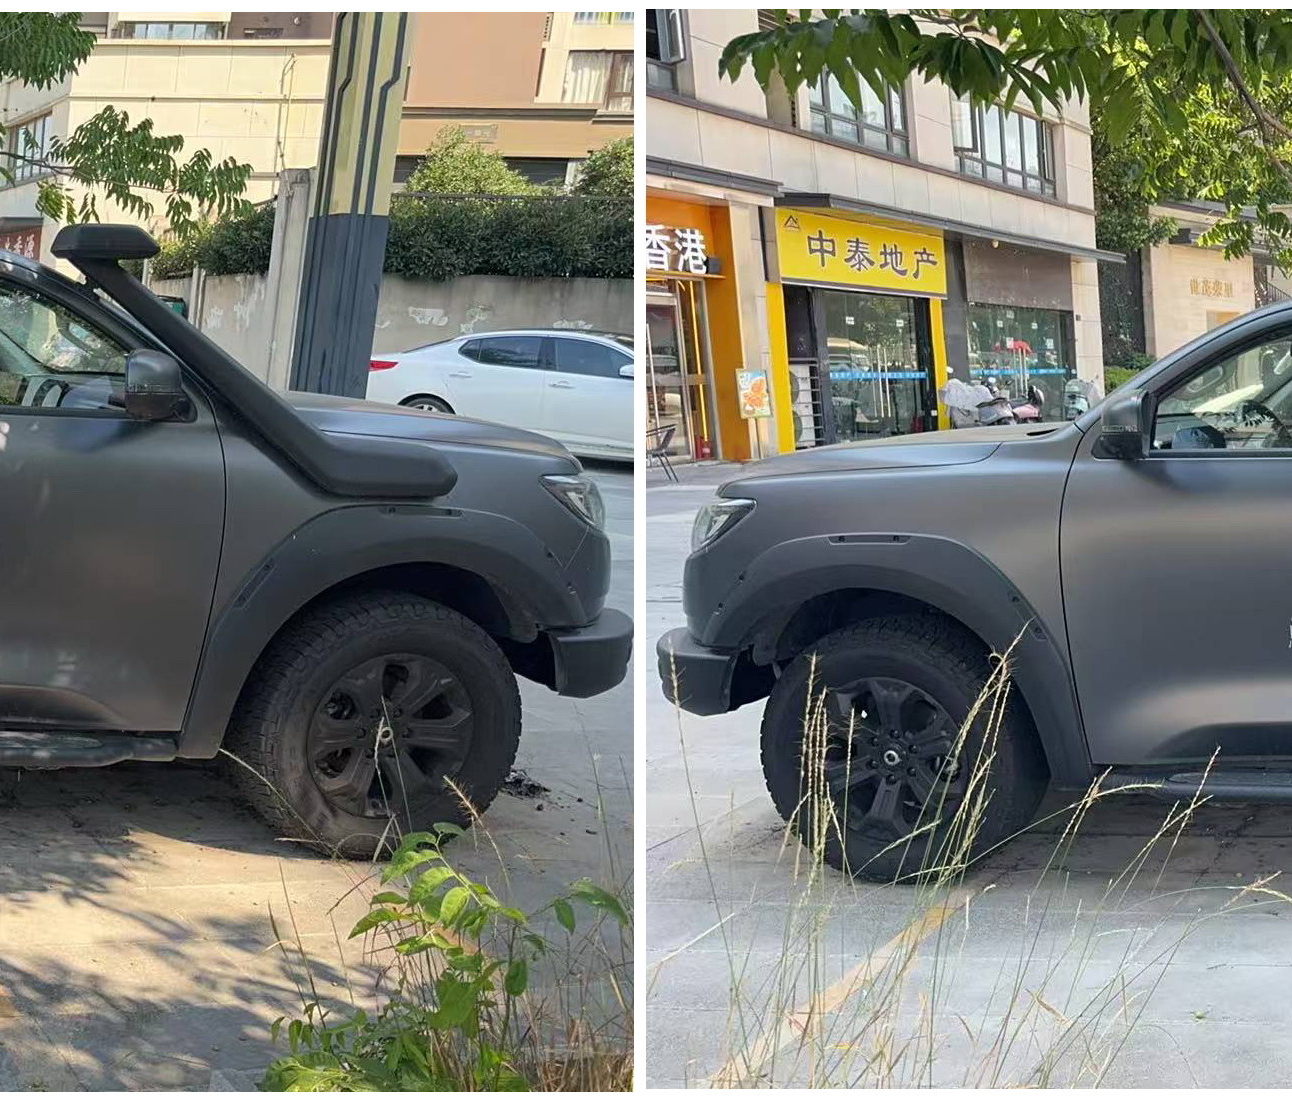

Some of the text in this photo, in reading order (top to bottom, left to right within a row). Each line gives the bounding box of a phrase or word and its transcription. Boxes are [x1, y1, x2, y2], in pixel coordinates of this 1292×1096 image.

[645, 224, 707, 274] 香港
[807, 229, 938, 279] 中泰地产
